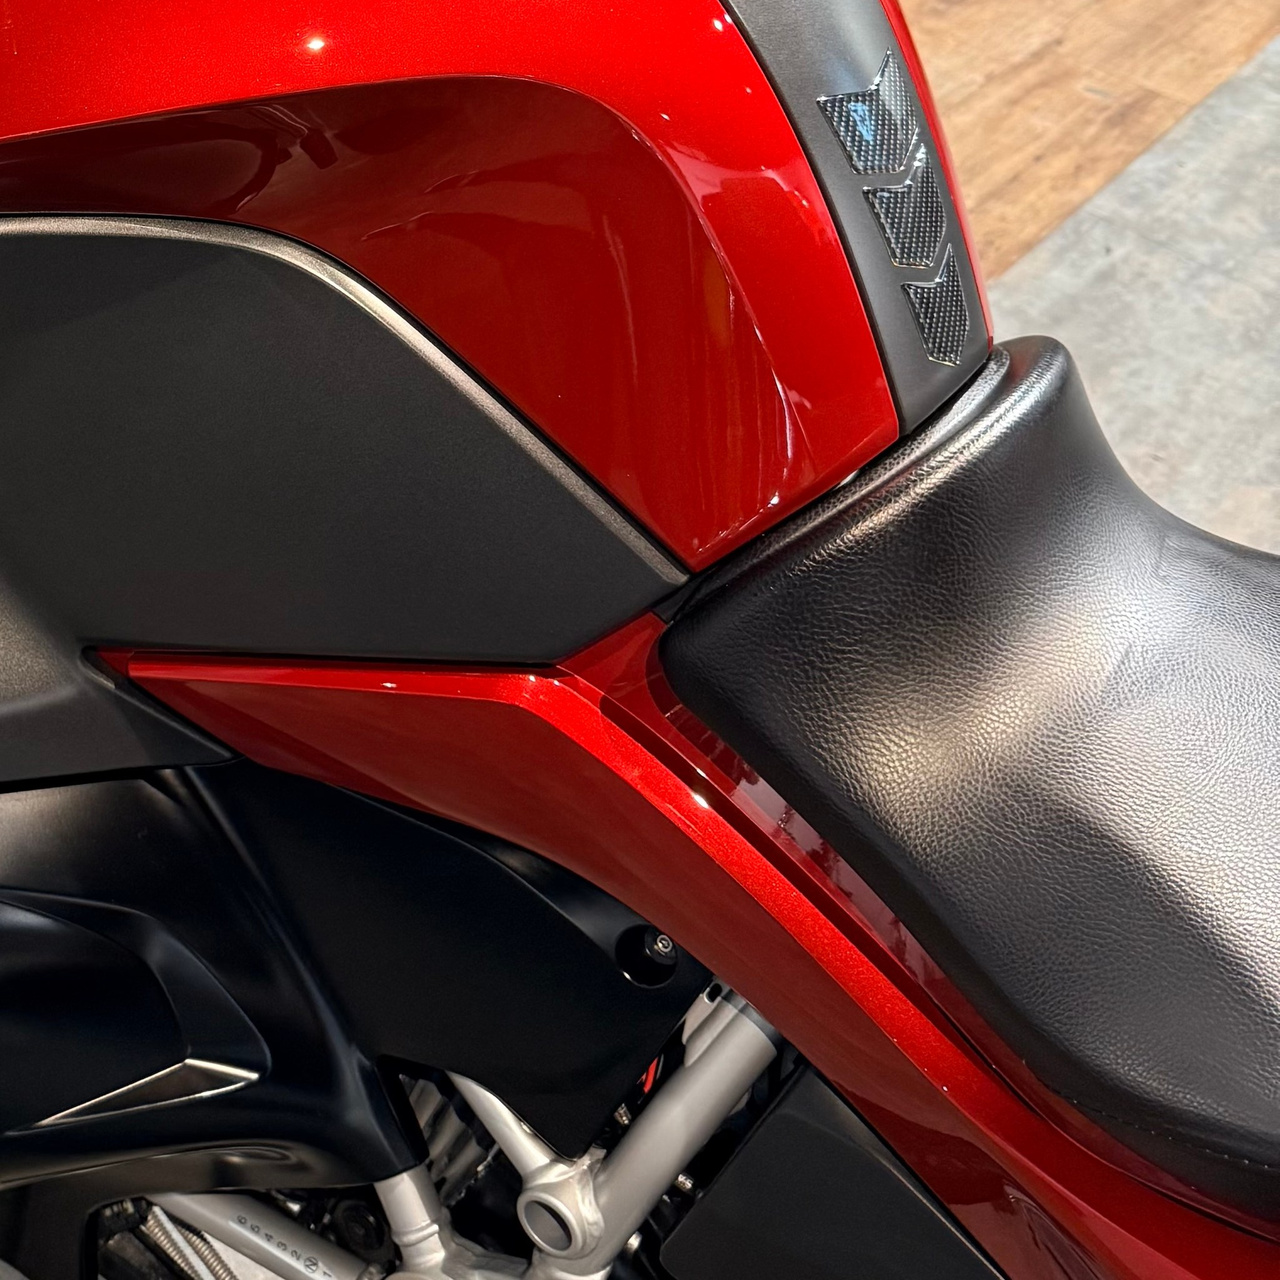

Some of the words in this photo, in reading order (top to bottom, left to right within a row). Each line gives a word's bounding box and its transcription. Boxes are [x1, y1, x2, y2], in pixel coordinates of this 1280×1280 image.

[237, 1215, 248, 1225] 6
[250, 1223, 260, 1233] 5
[264, 1232, 274, 1242] 4
[277, 1241, 287, 1251] 3
[290, 1249, 302, 1261] 2
[322, 1270, 332, 1278] 1
